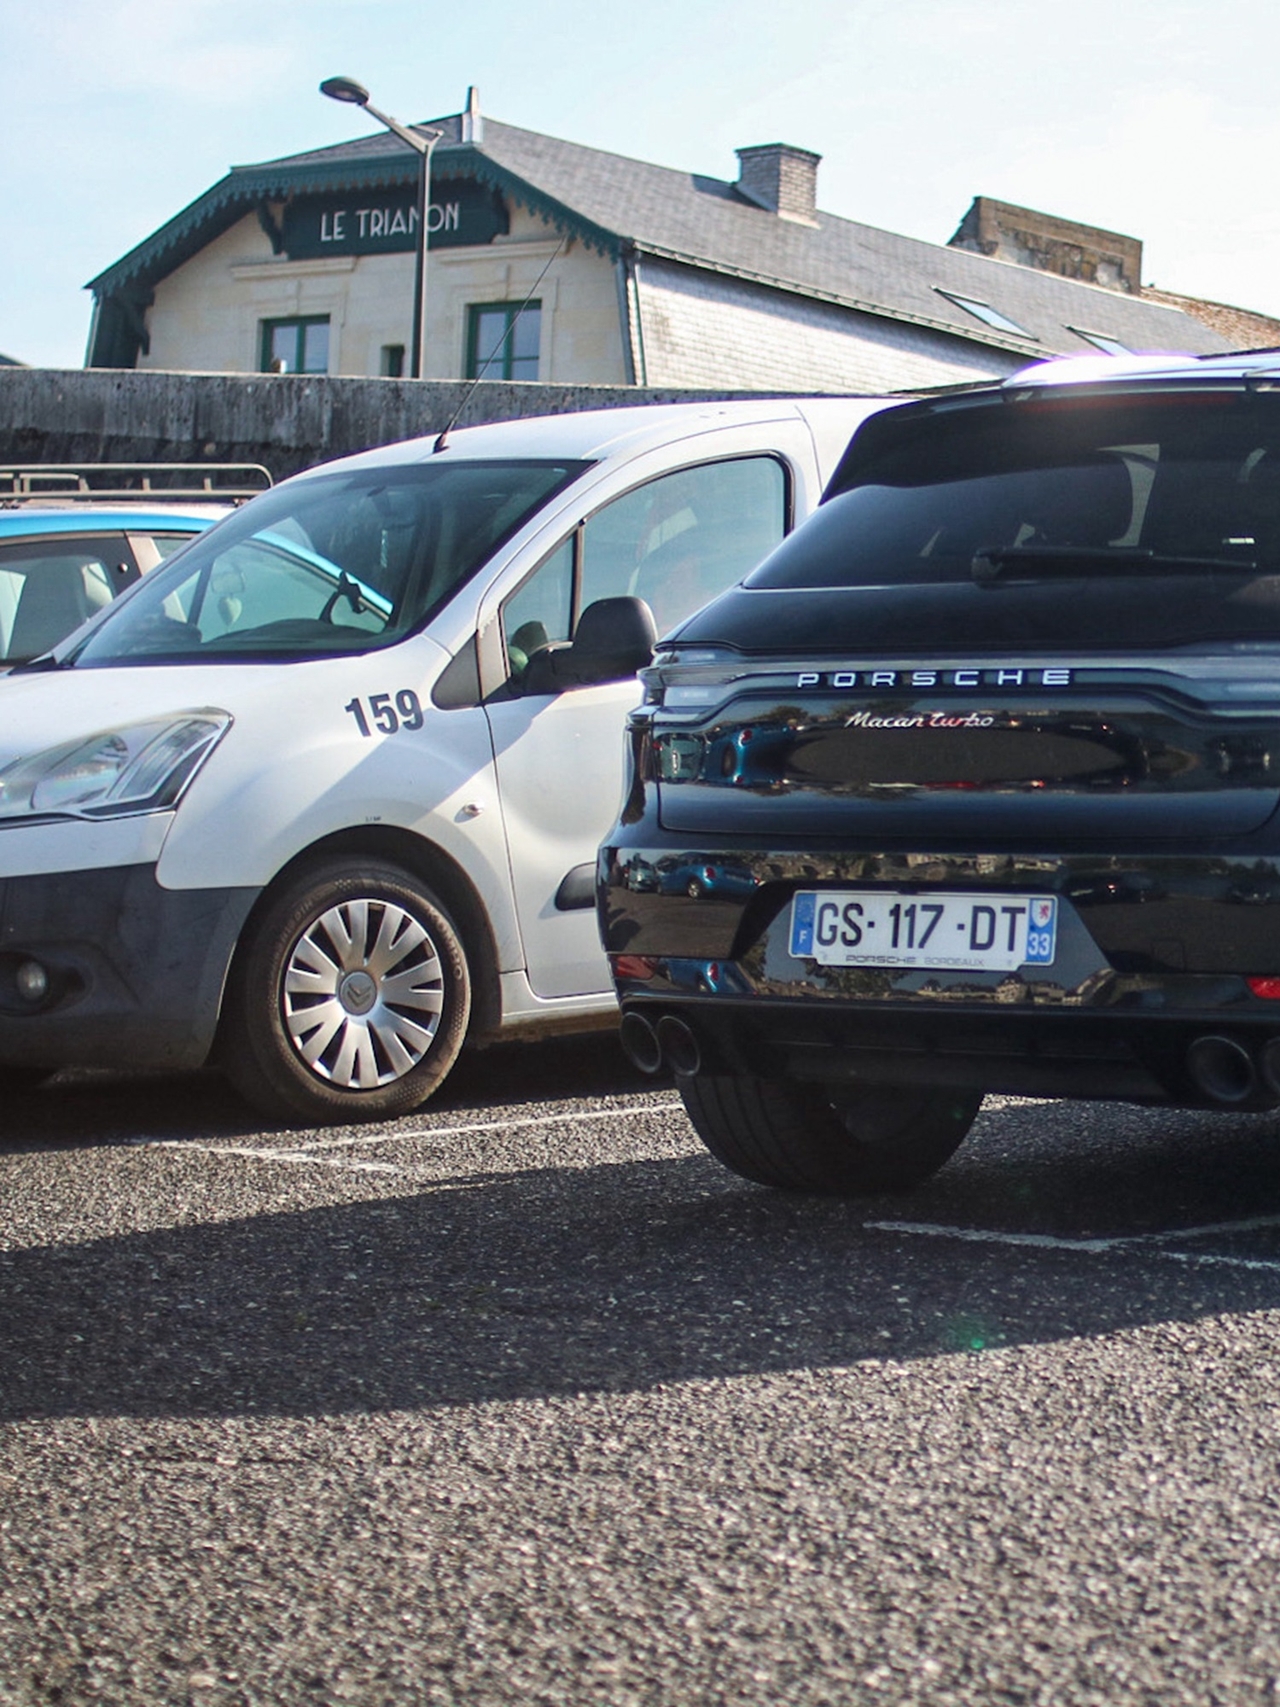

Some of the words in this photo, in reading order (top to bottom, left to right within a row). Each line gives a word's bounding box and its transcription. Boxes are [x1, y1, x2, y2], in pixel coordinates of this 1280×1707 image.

[321, 211, 346, 242] LE
[797, 669, 1071, 688] PORSCHE
[344, 689, 424, 737] 159
[844, 711, 924, 728] Macan
[799, 931, 807, 943] F
[1028, 933, 1049, 955] 33
[846, 955, 916, 965] PORSCHE
[924, 957, 985, 968] BORDEAUX
